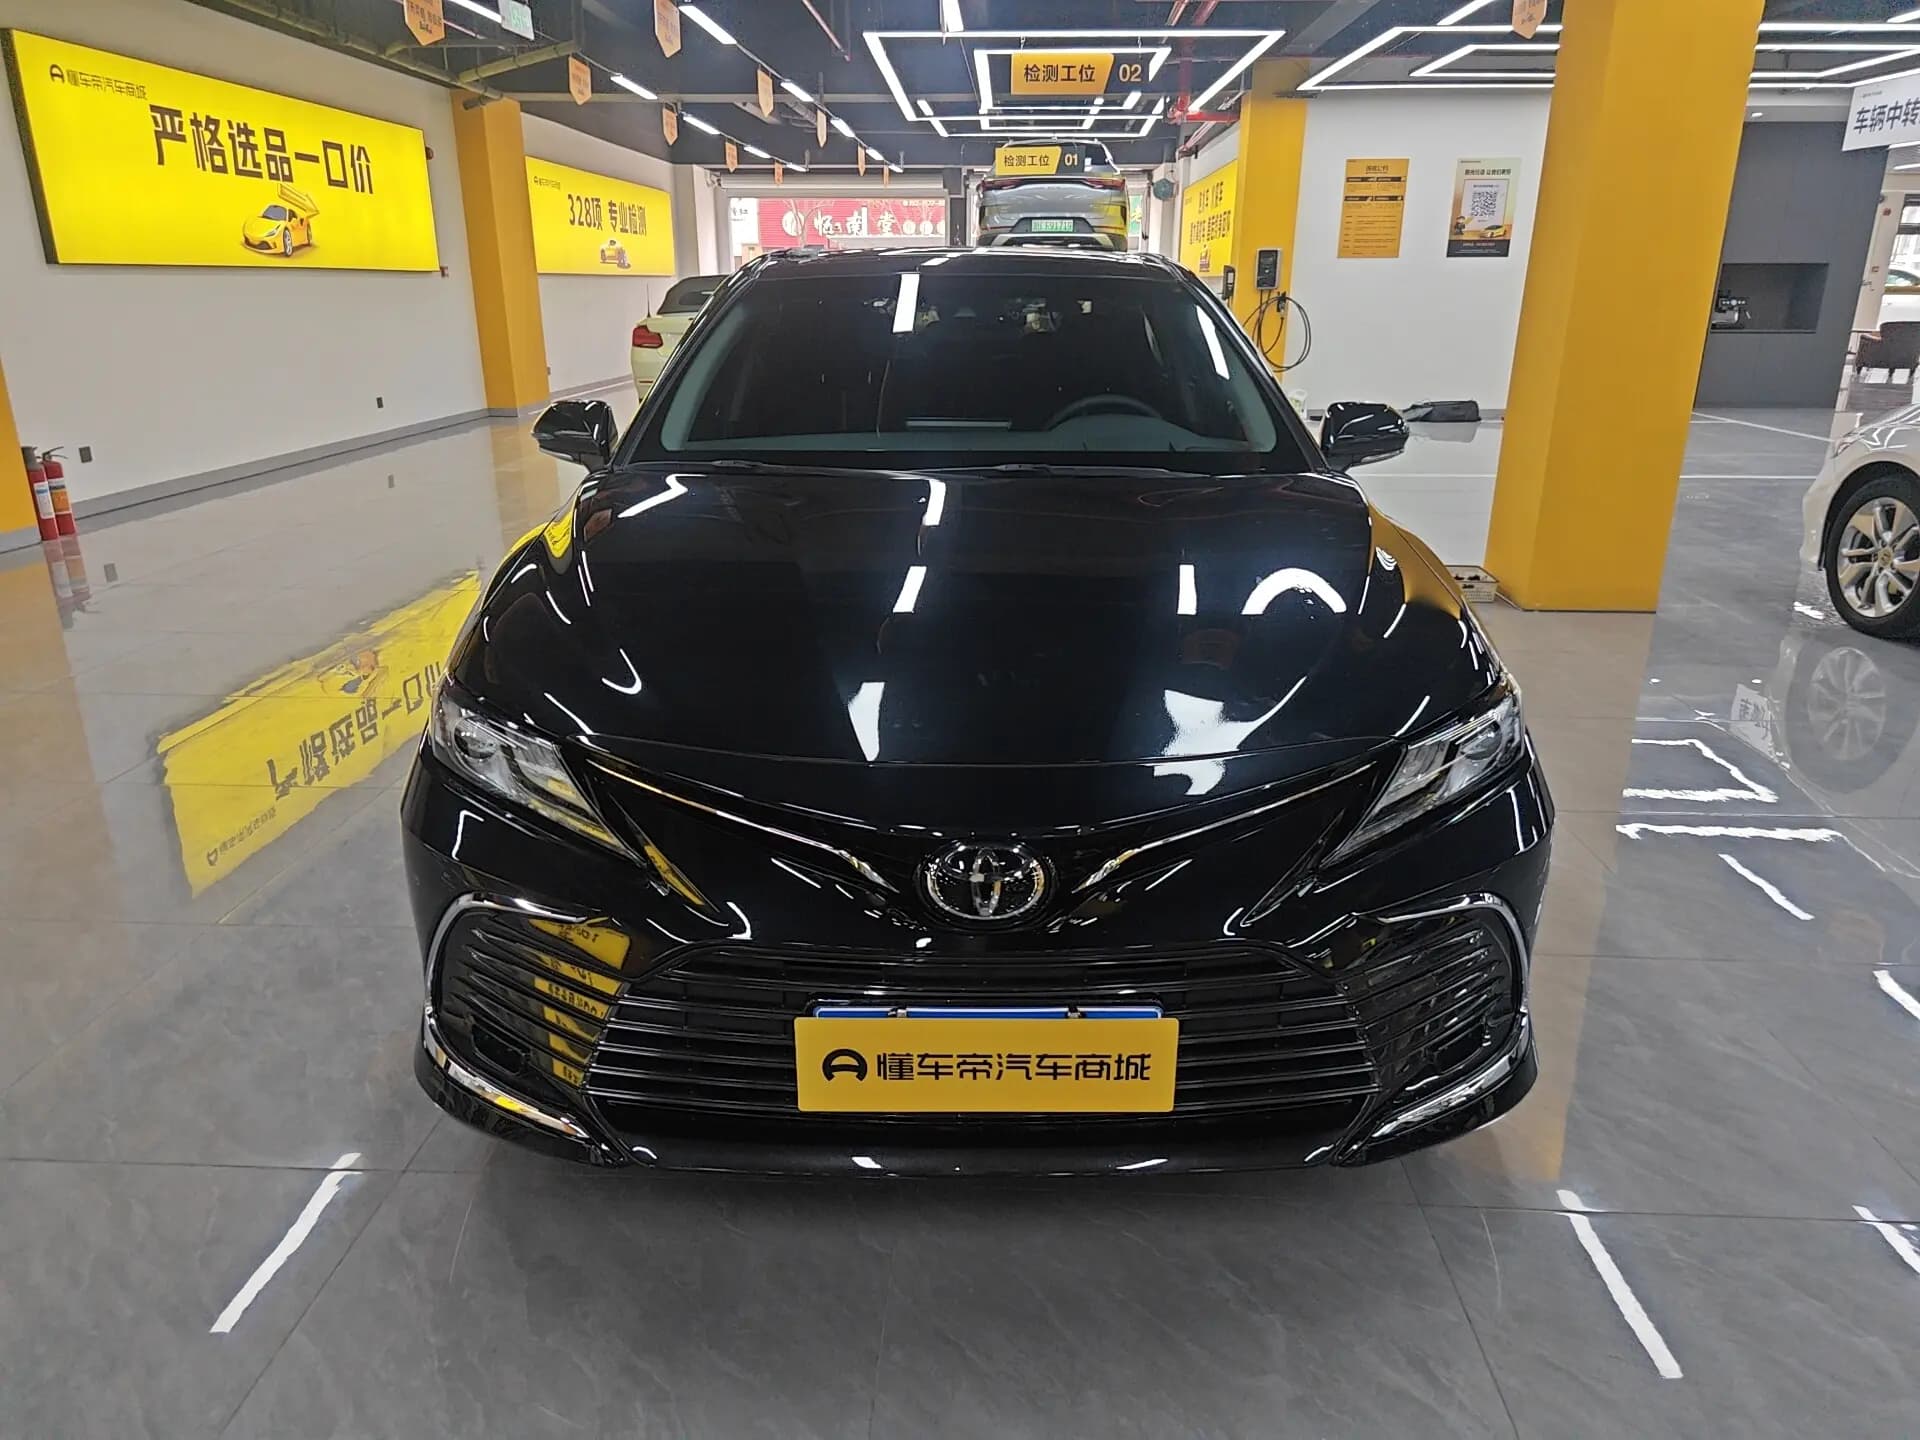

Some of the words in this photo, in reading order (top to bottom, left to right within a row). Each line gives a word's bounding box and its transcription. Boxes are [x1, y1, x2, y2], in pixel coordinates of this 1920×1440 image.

[1023, 63, 1096, 83] 检测工位
[1119, 63, 1142, 83] 02
[149, 104, 374, 195] 严格选品一口价
[1003, 154, 1050, 168] 检测工位
[1064, 153, 1078, 166] 01
[567, 193, 603, 231] 328项
[608, 200, 647, 237] 专业检测
[876, 1052, 1152, 1082] 懂车帝汽车商城
